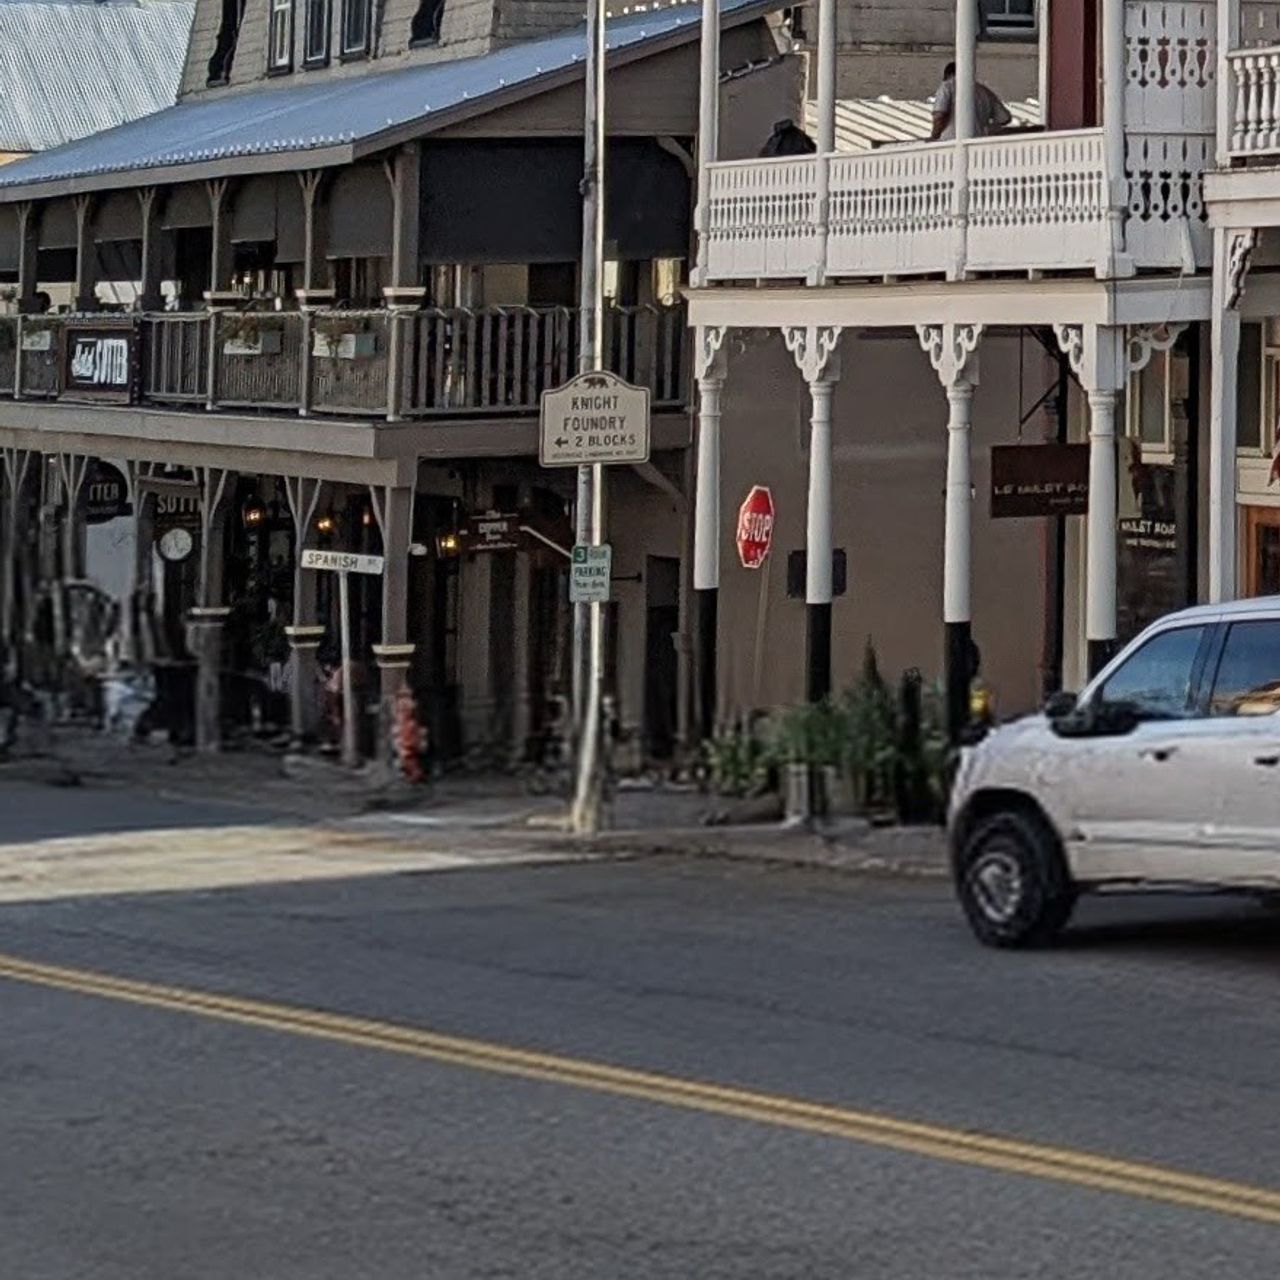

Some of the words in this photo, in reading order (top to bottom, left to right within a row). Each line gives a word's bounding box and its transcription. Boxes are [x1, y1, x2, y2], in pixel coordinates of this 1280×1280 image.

[571, 395, 619, 411] KNIGHT
[563, 415, 626, 431] FOUNDRY
[575, 435, 583, 447] 2
[588, 434, 636, 447] BLOCKS
[156, 495, 202, 514] SUTT
[741, 511, 773, 542] STOP
[307, 553, 358, 569] SPANISH
[575, 548, 585, 562] 3
